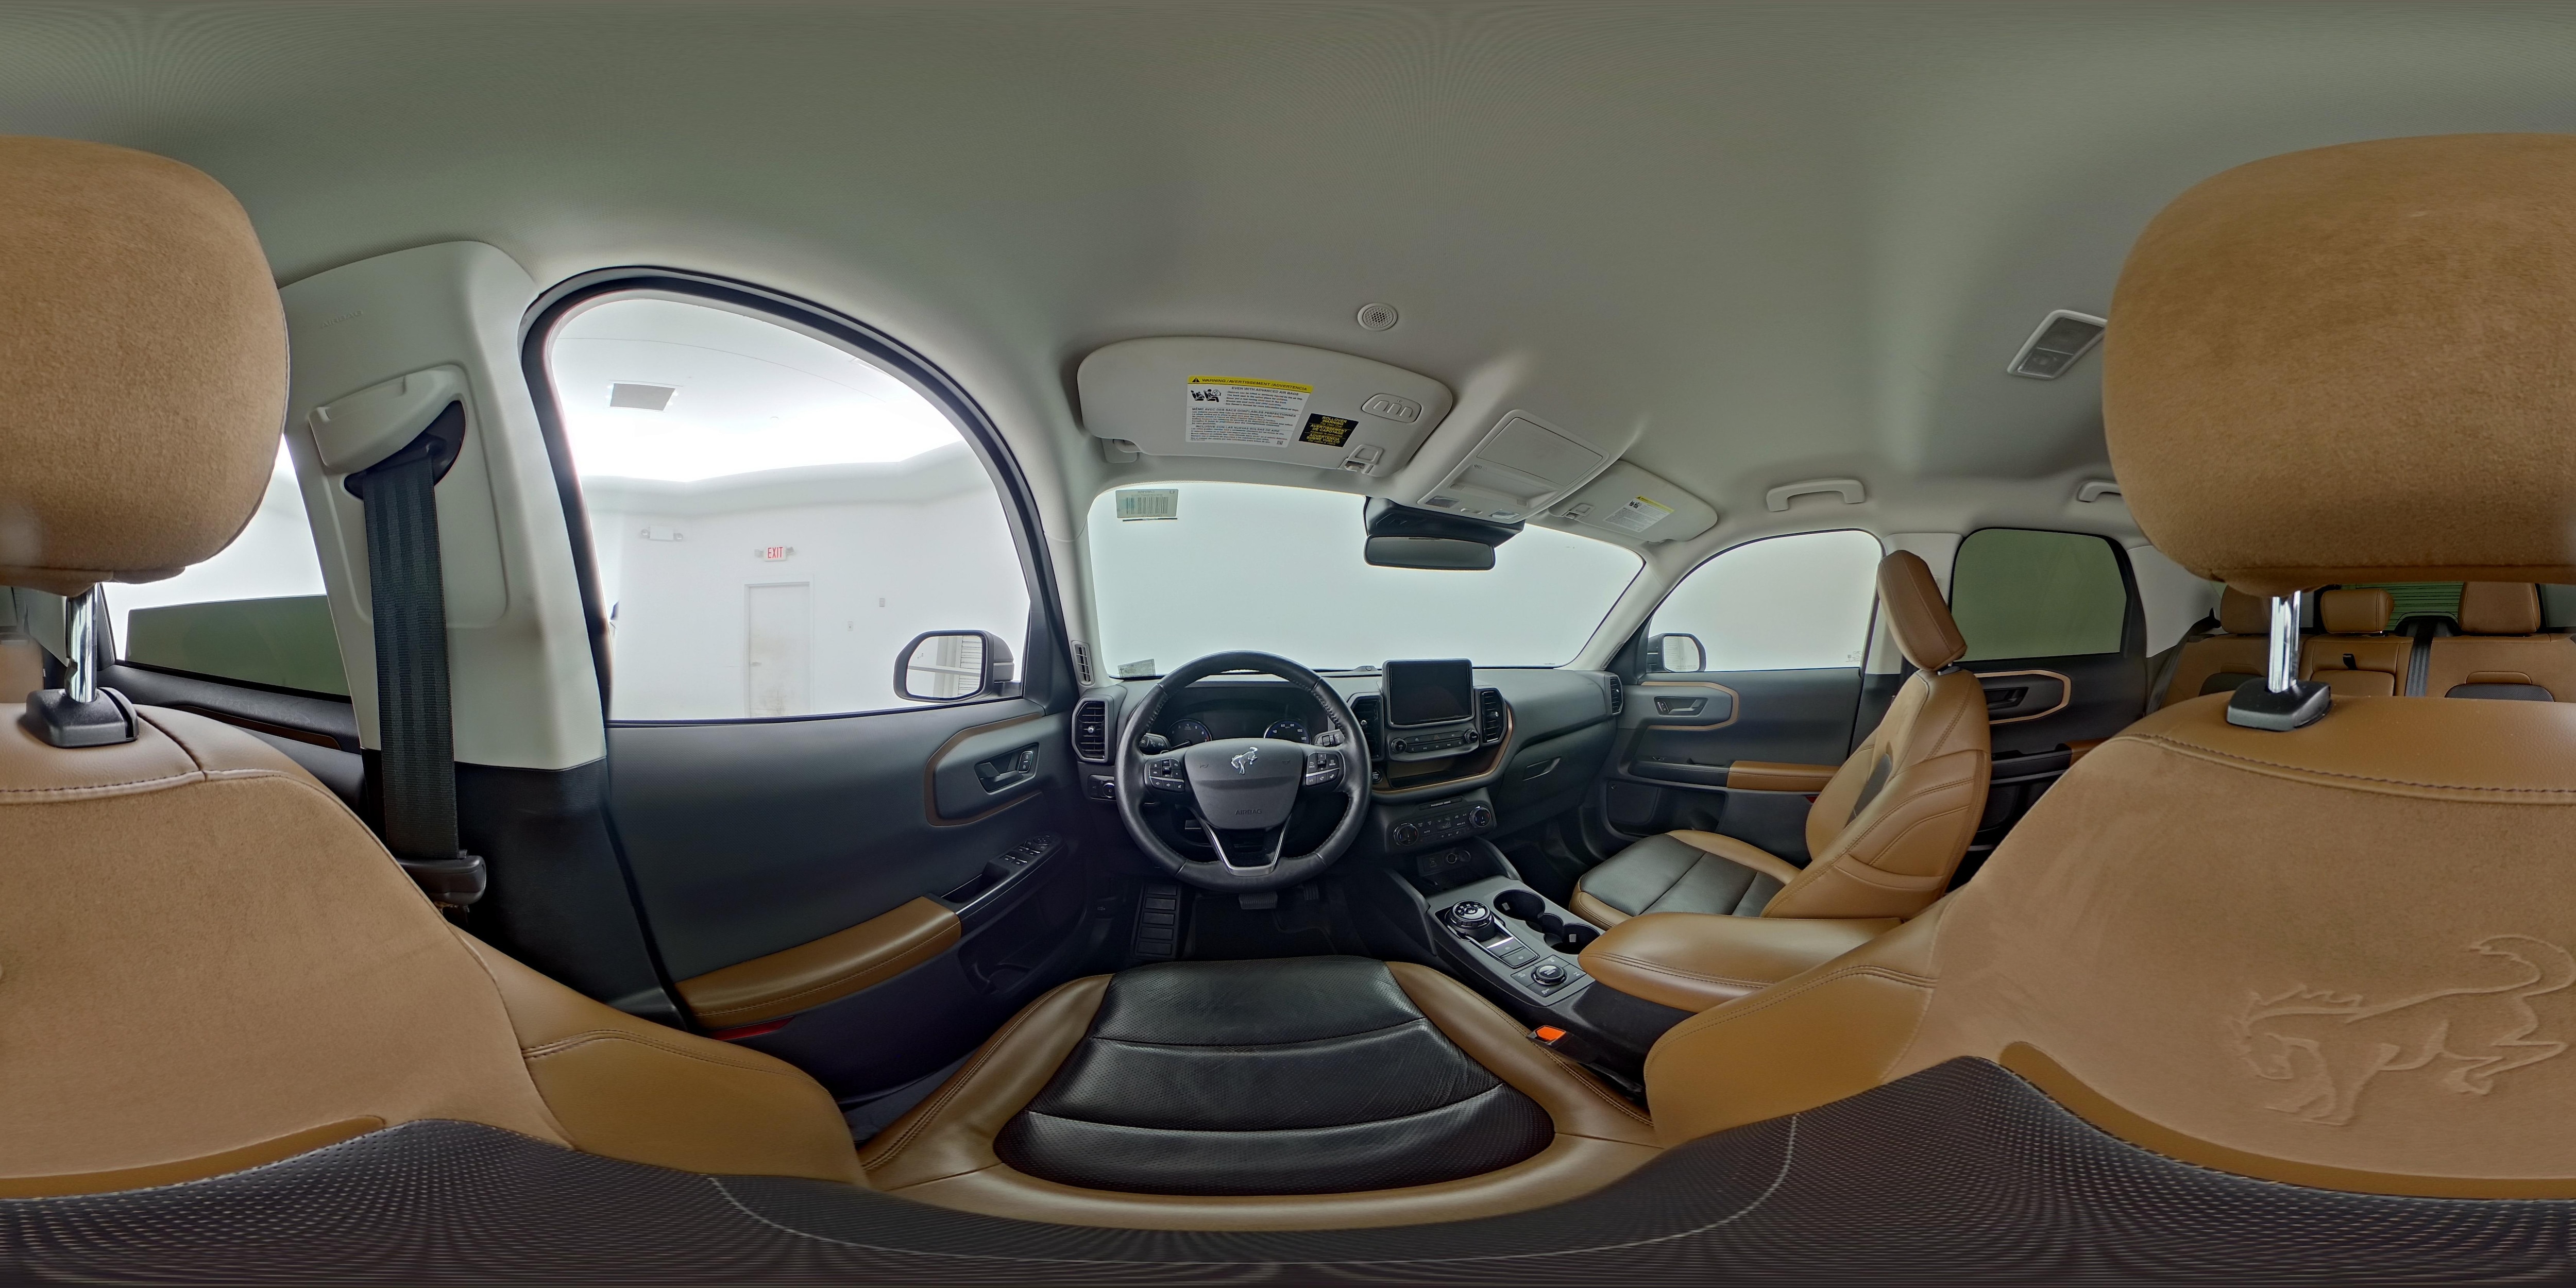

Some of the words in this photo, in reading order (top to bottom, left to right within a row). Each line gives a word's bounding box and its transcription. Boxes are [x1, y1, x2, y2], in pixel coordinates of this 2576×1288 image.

[321, 310, 363, 328] AIRBAG
[1310, 424, 1347, 433] AVERTISSEMENT
[767, 547, 783, 559] EXIT
